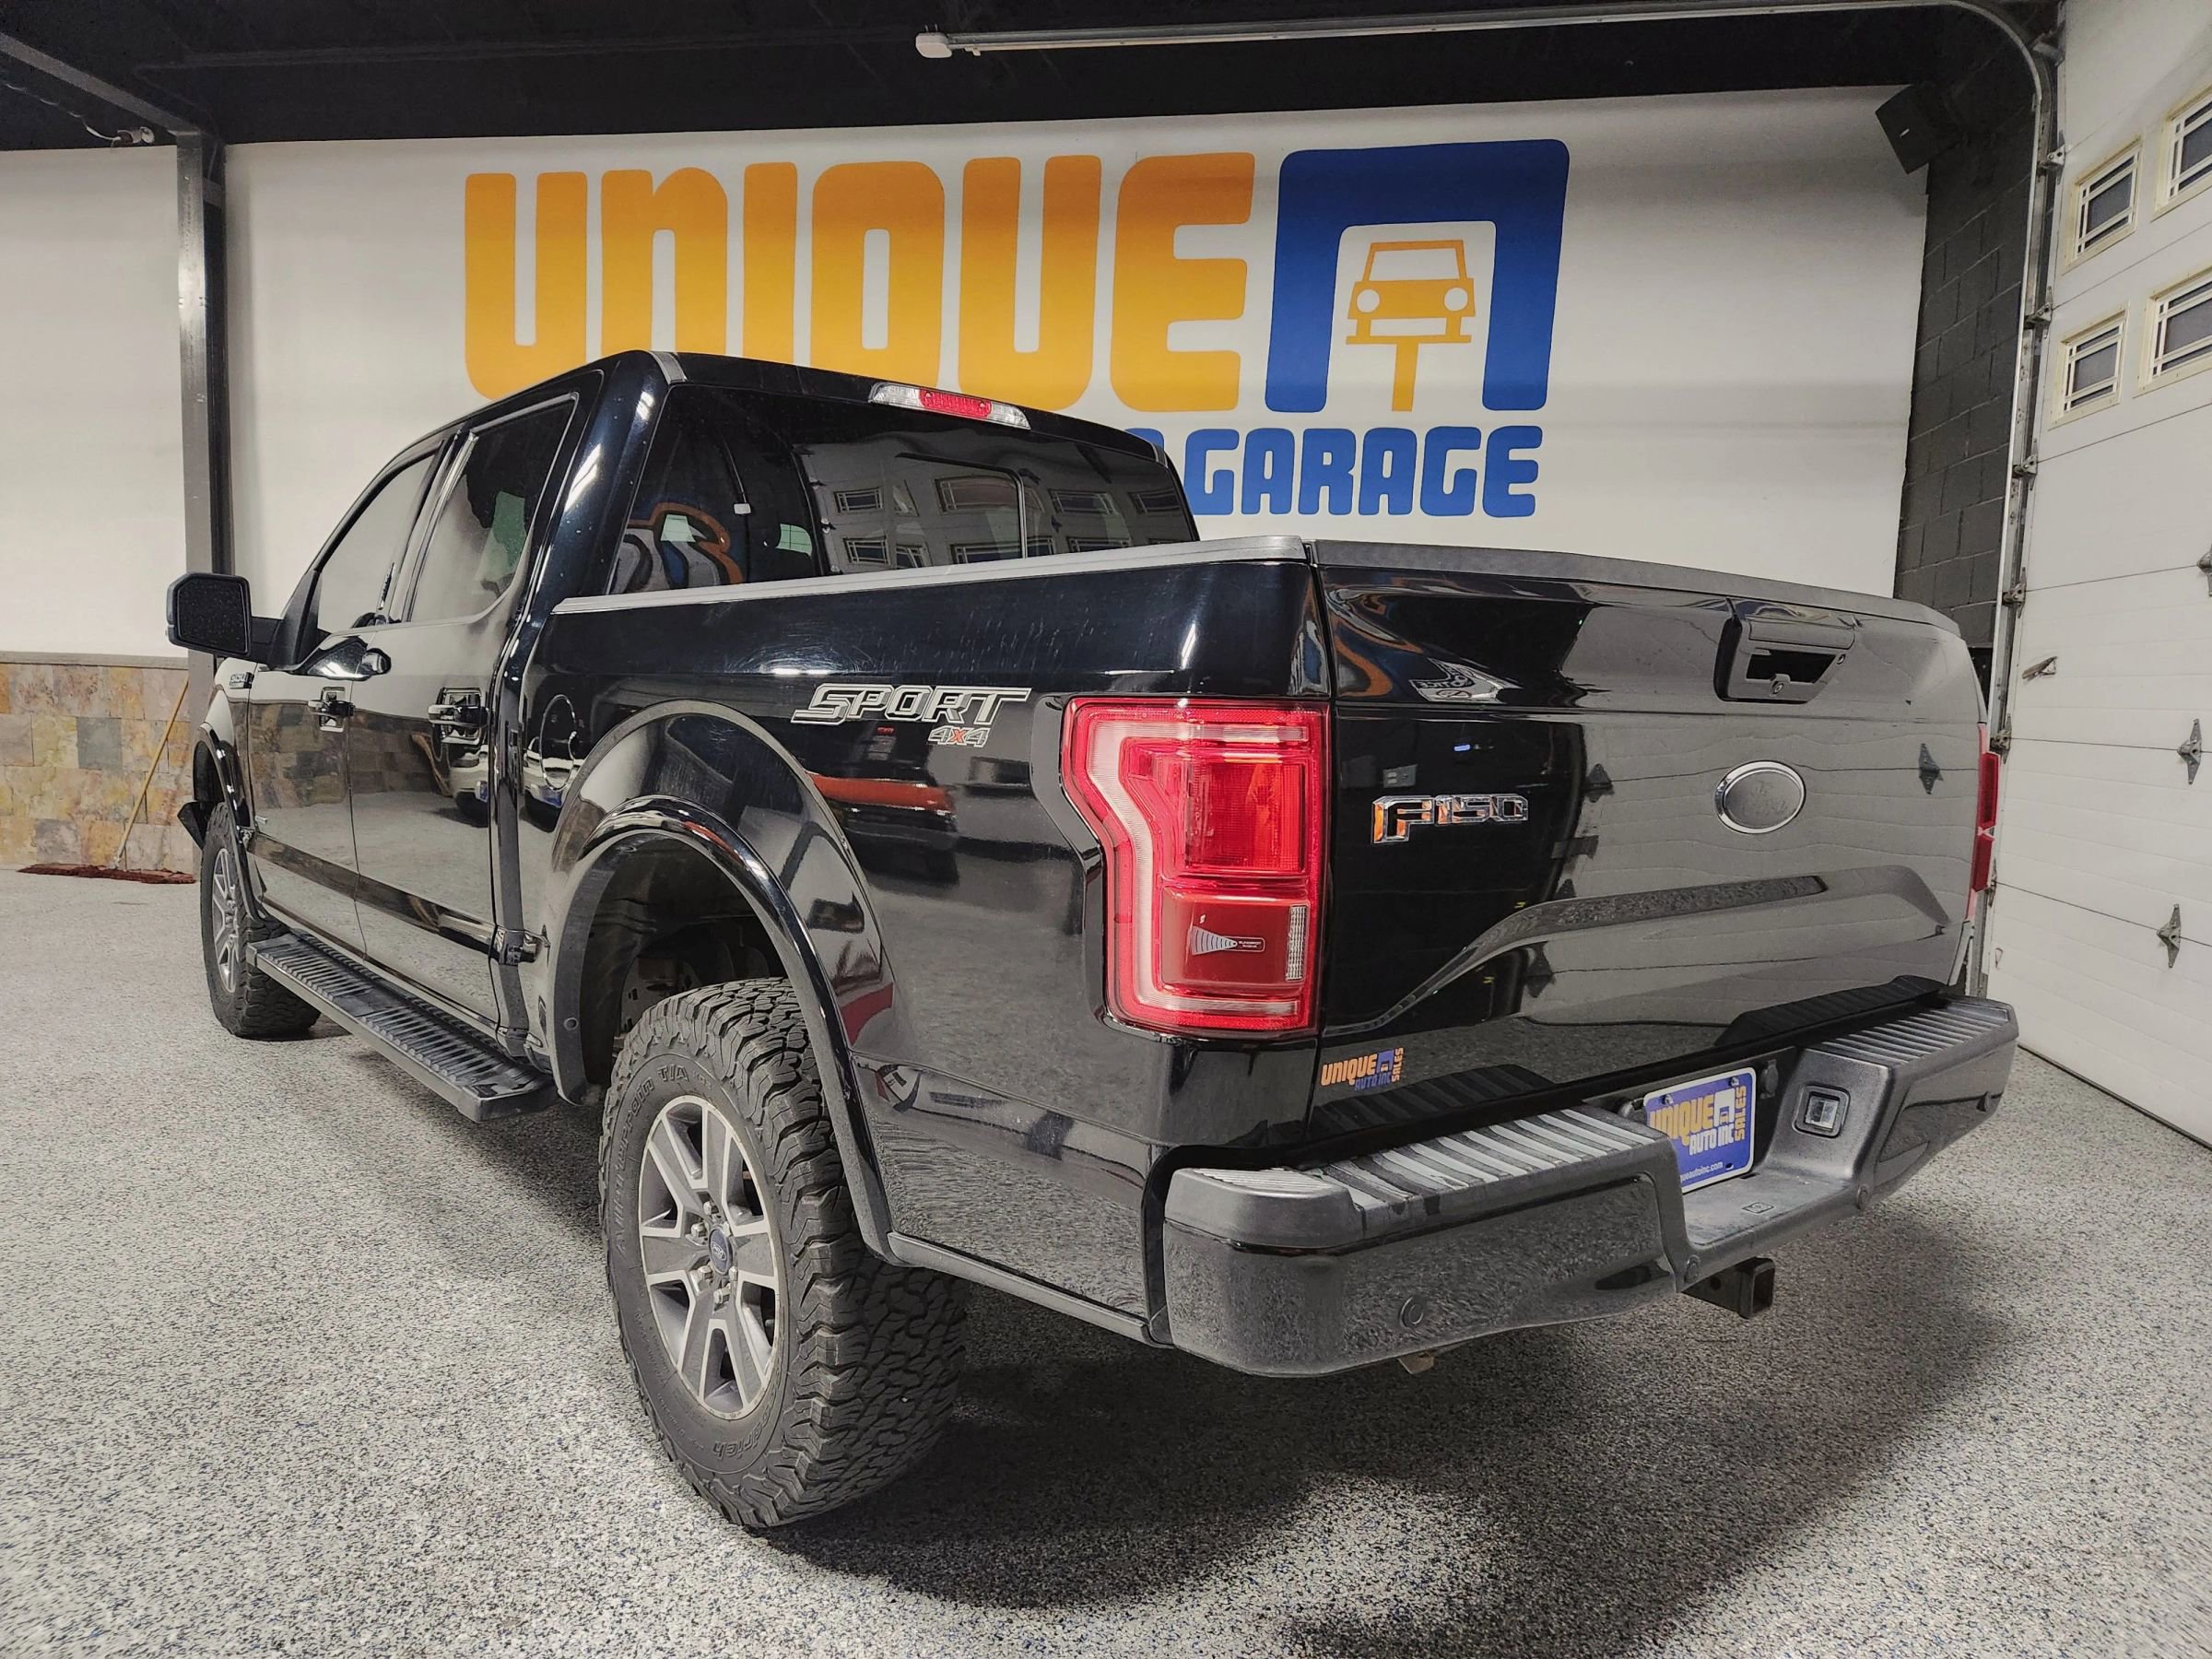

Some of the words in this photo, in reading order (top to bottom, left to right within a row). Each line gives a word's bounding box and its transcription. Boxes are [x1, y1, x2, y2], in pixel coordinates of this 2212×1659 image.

[464, 153, 1255, 412] UNIQUE
[1183, 425, 1543, 518] GARAGE
[791, 683, 1031, 725] SPORT
[1320, 1053, 1378, 1087] UNIQUE
[1354, 1075, 1376, 1091] AUTO
[1391, 1047, 1405, 1083] SALES
[1650, 1094, 1715, 1147] UNIQUE
[1734, 1086, 1747, 1141] SALES
[1689, 1127, 1717, 1156] AUTO
[1717, 1123, 1735, 1147] INC
